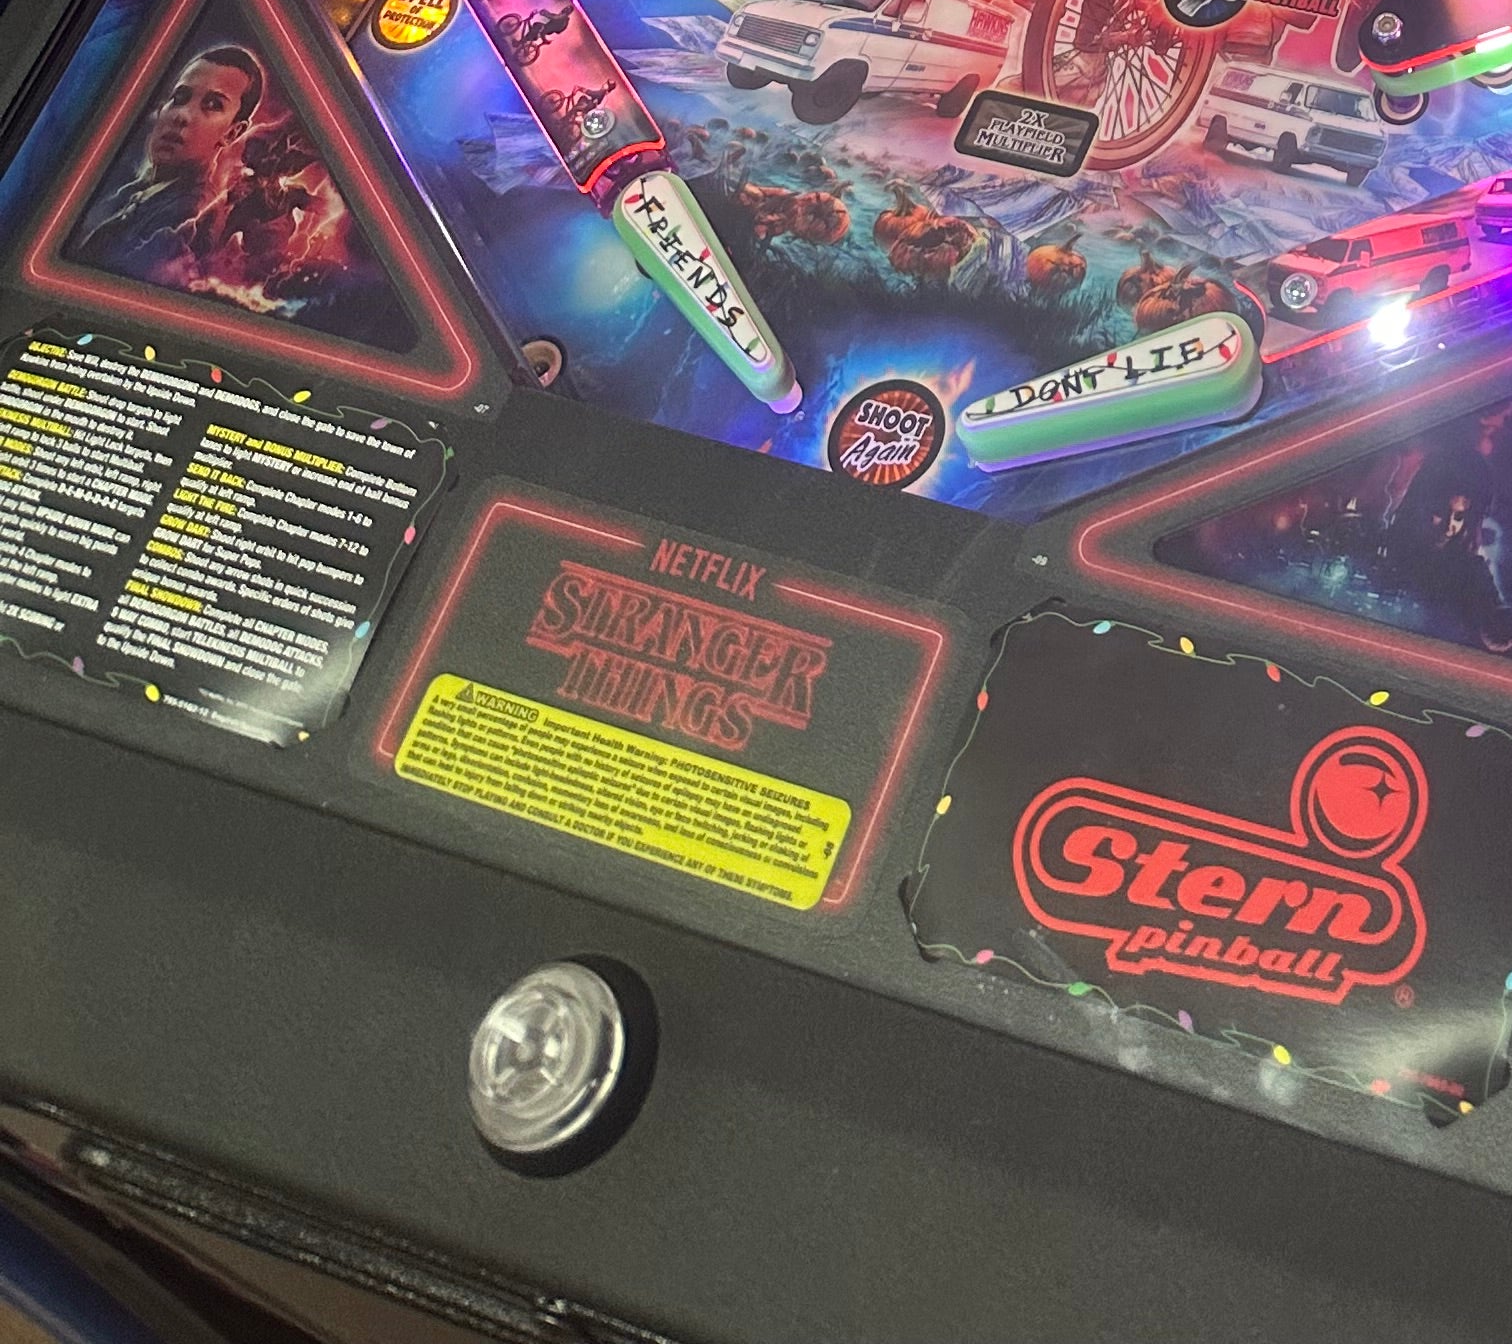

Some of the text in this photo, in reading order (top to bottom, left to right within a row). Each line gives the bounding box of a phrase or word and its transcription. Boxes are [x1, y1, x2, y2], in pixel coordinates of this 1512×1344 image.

[383, 10, 437, 30] PROTECTION
[409, 5, 423, 14] OF
[987, 118, 1066, 146] PLAYFIELD
[1019, 108, 1049, 128] 2X
[975, 128, 1067, 165] MULTIPLIER
[632, 195, 744, 329] FRIENDS
[1125, 337, 1203, 378] LIE
[205, 423, 247, 445] MYSTERY
[243, 435, 264, 450] and
[857, 399, 933, 439] SHOOT
[185, 461, 211, 478] SEND
[208, 468, 220, 481] IT
[840, 430, 919, 474] Again
[172, 487, 199, 504] LIGHT
[196, 494, 216, 509] THE
[649, 538, 766, 602] NETFLIX
[528, 568, 828, 724] STRANGER
[556, 645, 751, 753] THINGS
[473, 690, 811, 812] WARNING Important Health Warning: PHOTOSENSITIVE SEIZURES
[1063, 826, 1387, 945] Stern
[1125, 920, 1342, 982] pinball
